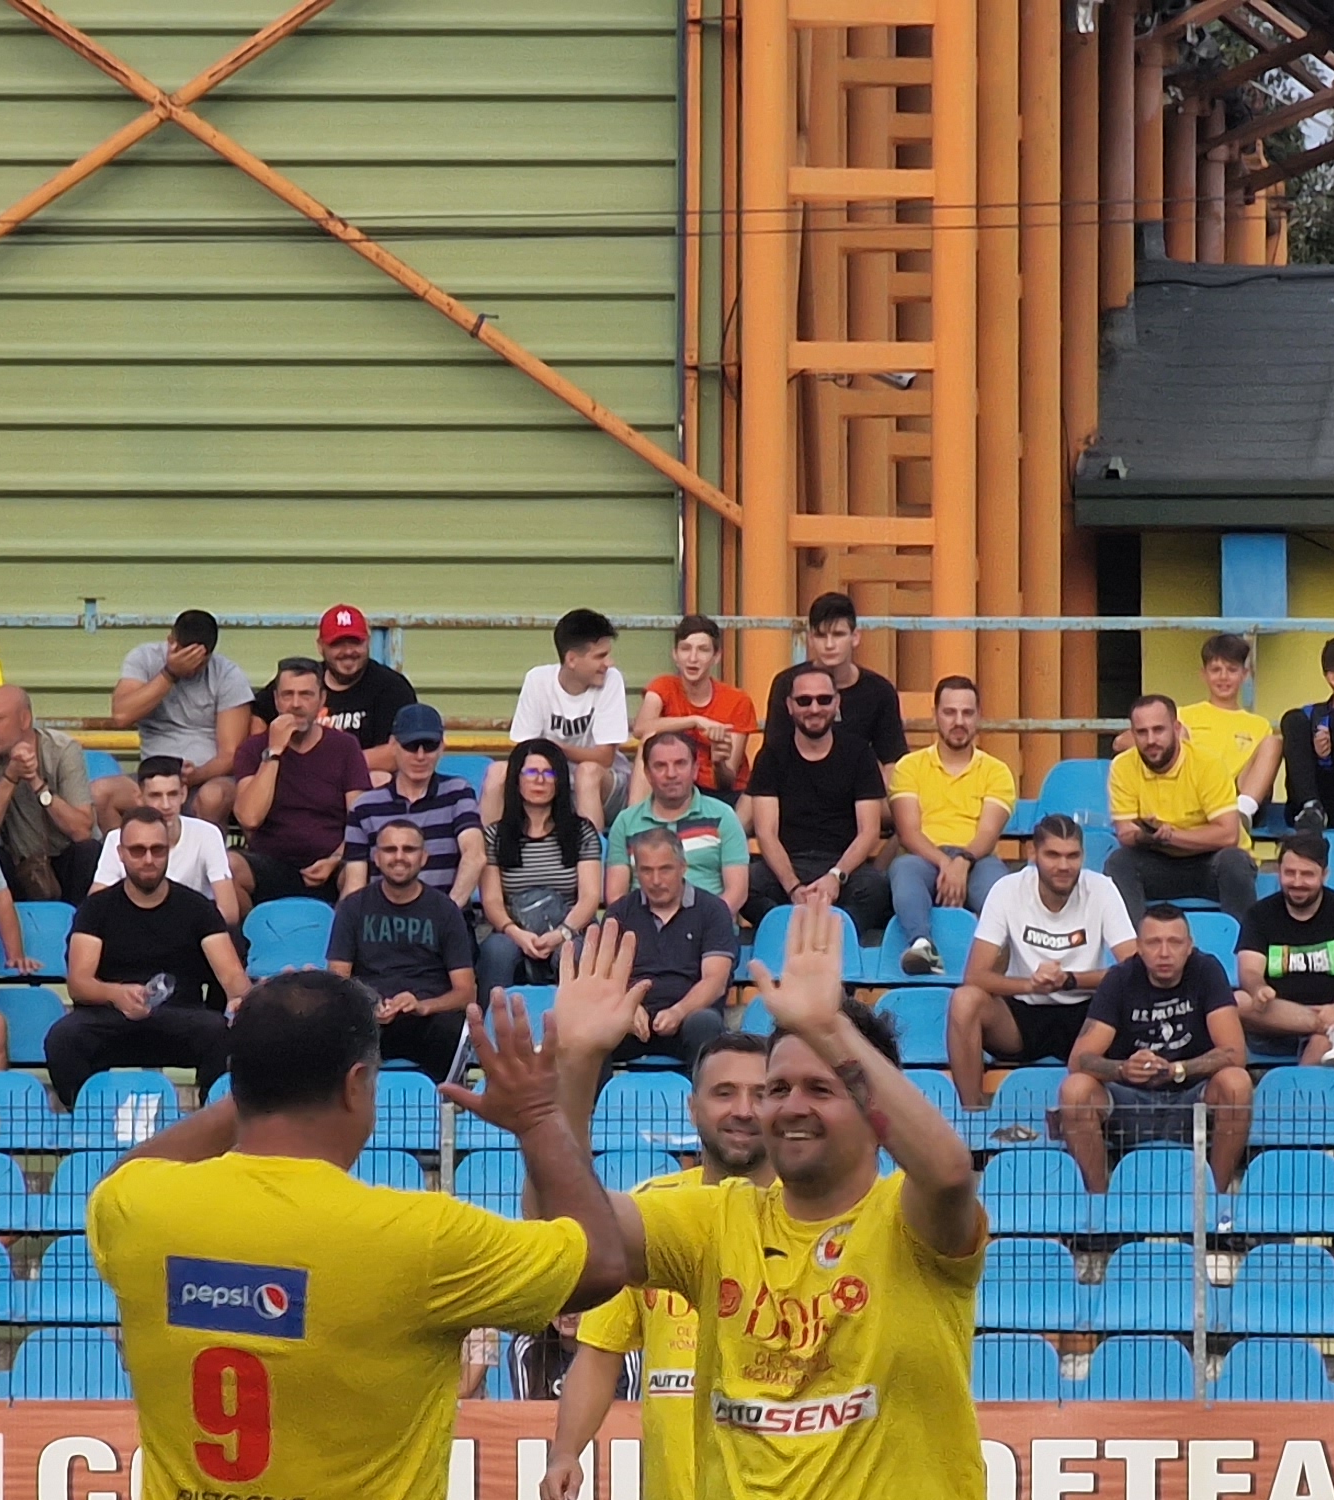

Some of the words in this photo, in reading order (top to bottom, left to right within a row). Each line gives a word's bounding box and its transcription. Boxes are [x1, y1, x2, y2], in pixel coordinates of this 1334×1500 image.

[363, 914, 434, 945] KAPPA
[181, 1283, 252, 1307] pepsi
[192, 1346, 272, 1484] 9
